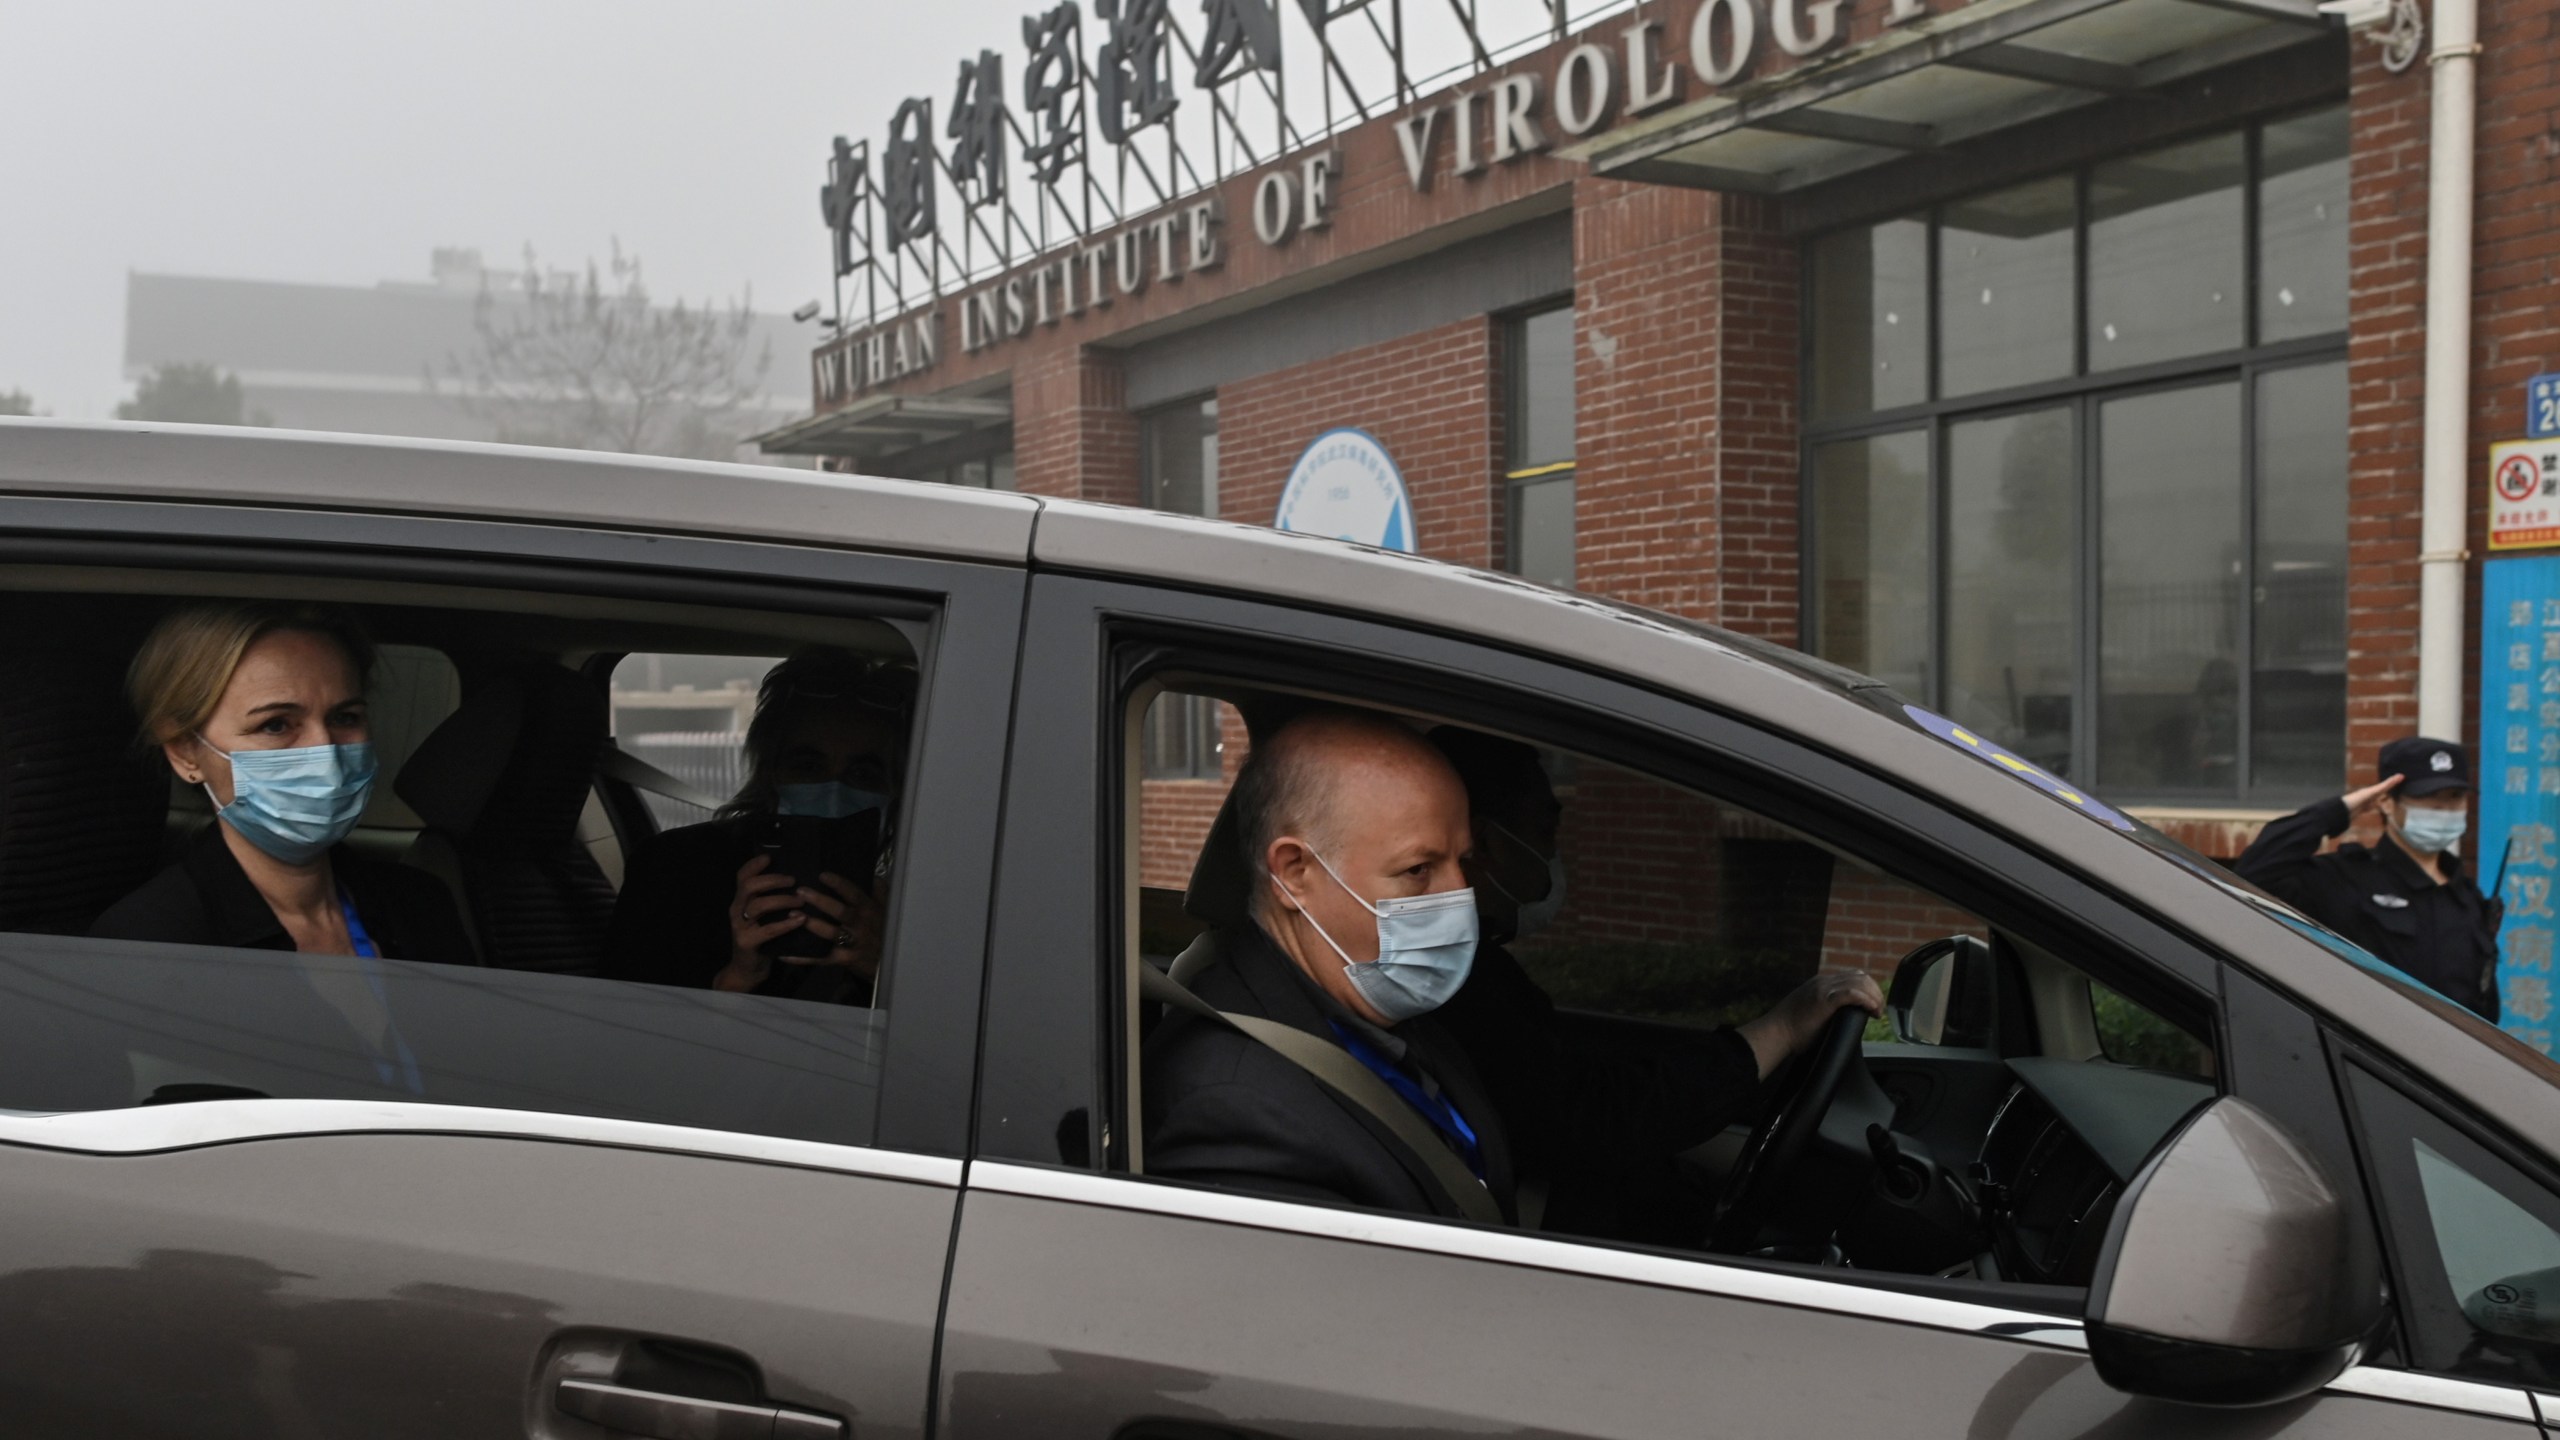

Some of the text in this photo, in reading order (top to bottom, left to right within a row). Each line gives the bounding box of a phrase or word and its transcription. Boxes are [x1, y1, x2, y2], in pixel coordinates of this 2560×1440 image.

[815, 0, 1926, 398] WUHAN INSTITUTE OF VIROLOG
[2539, 398, 2560, 431] 2
